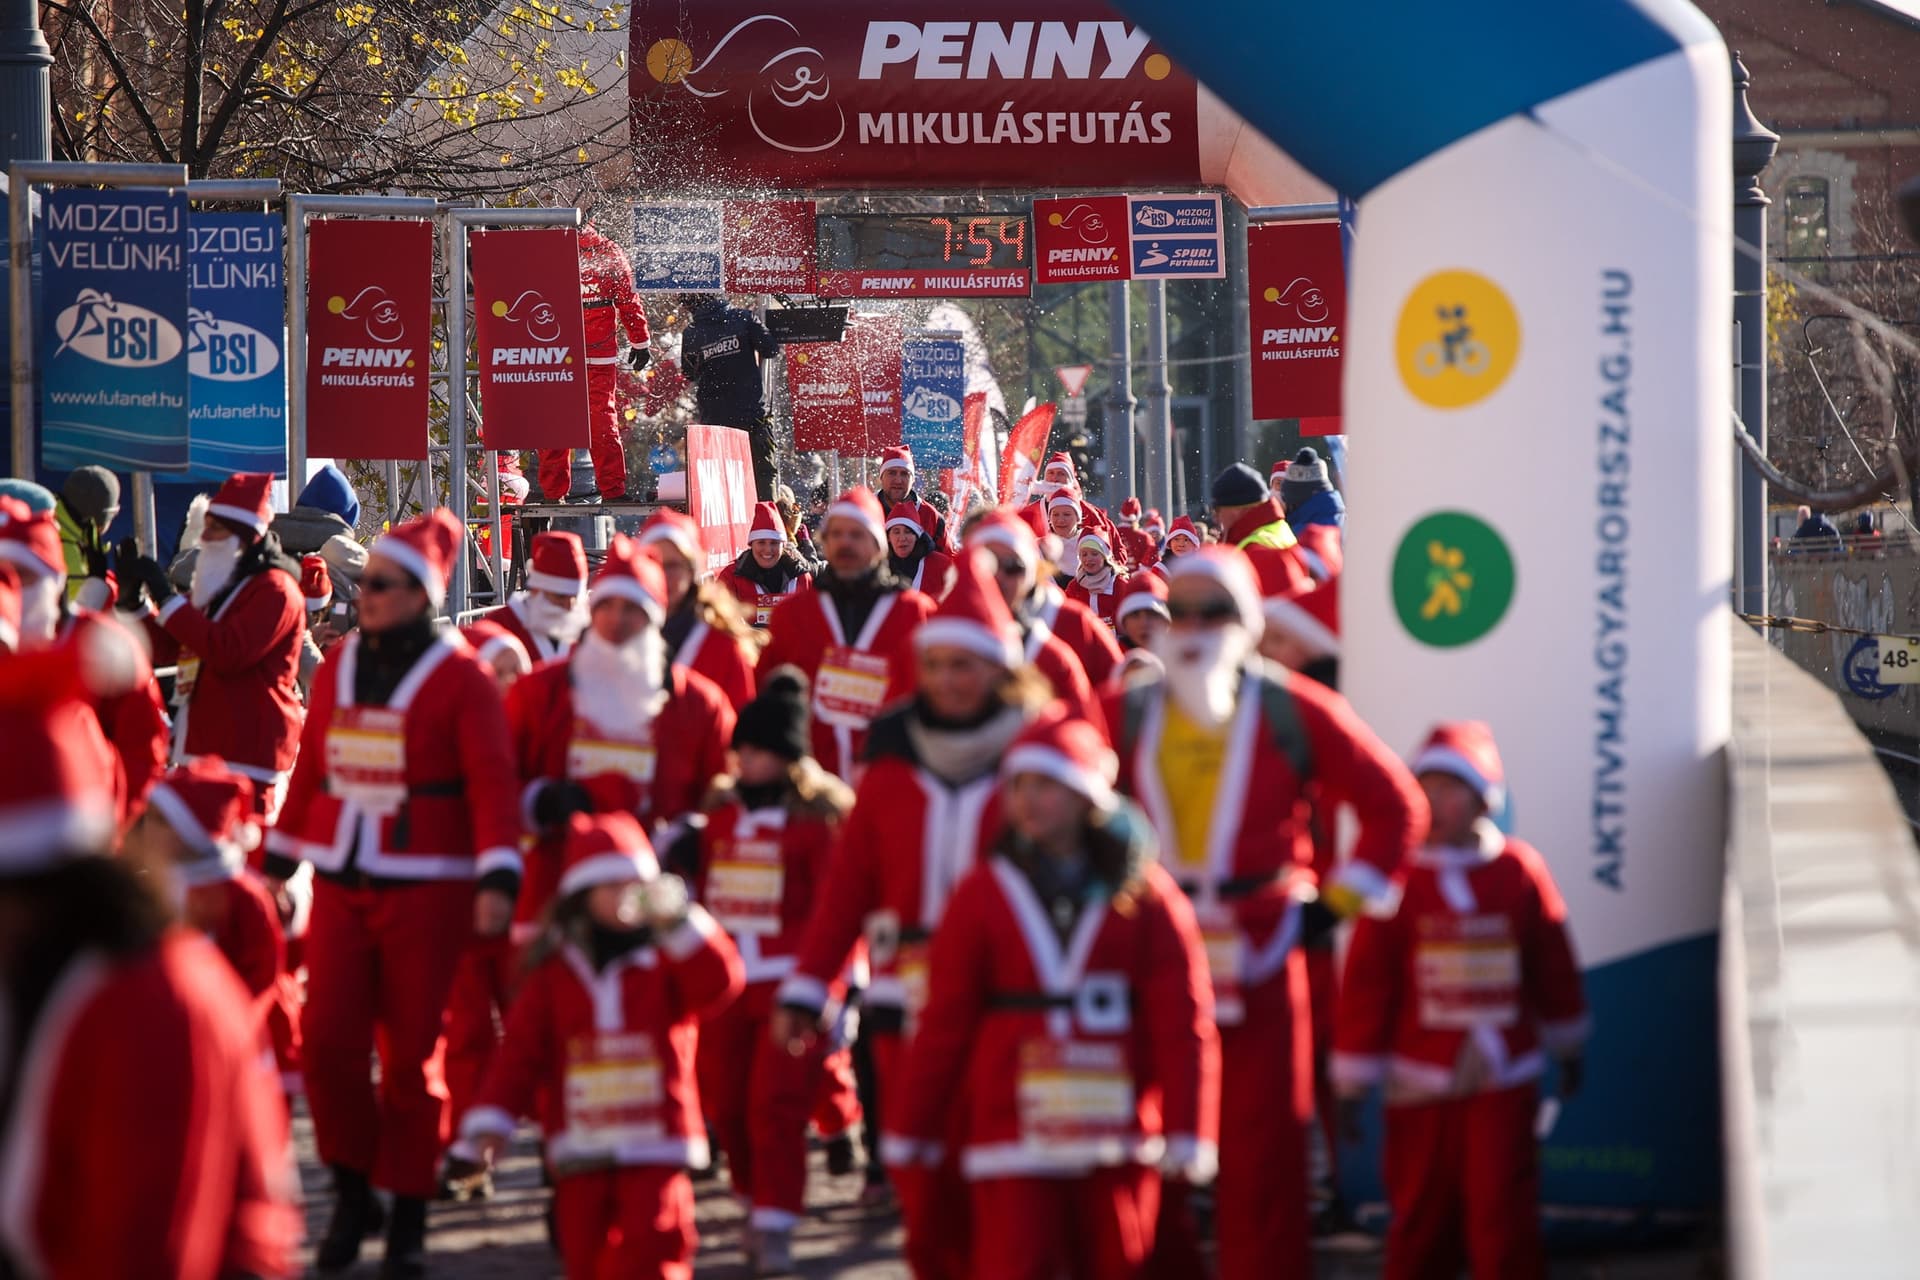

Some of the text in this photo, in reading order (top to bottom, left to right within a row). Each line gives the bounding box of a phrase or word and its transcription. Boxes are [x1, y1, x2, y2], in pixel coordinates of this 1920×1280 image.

[859, 102, 1172, 144] MIKULÁSFUTÁS
[49, 203, 179, 233] MOZOGJ
[1151, 213, 1167, 226] BSI
[1176, 208, 1212, 217] MOZOGJ
[1175, 217, 1214, 226] VELÜNK!
[931, 217, 1026, 265] 7:54
[48, 236, 181, 272] VELÜNK!
[1172, 248, 1212, 258] SPURI
[1048, 264, 1119, 277] MIKULÁSFUTÁS
[924, 272, 1024, 289] MIKULÁSFUTÁS
[107, 316, 158, 360] BSI
[209, 333, 257, 375] BSI
[1262, 346, 1340, 361] MIKULÁSFUTÁS
[321, 371, 415, 388] MIKULÁSFUTÁS
[492, 368, 574, 384] MIKULÁSFUTÁS
[51, 389, 183, 408] www.futanet.hu
[188, 403, 281, 420] w.futanet.hu
[1592, 268, 1634, 892] AKTIVMAGYARORSZAG.HU
[1883, 650, 1918, 668] 48-
